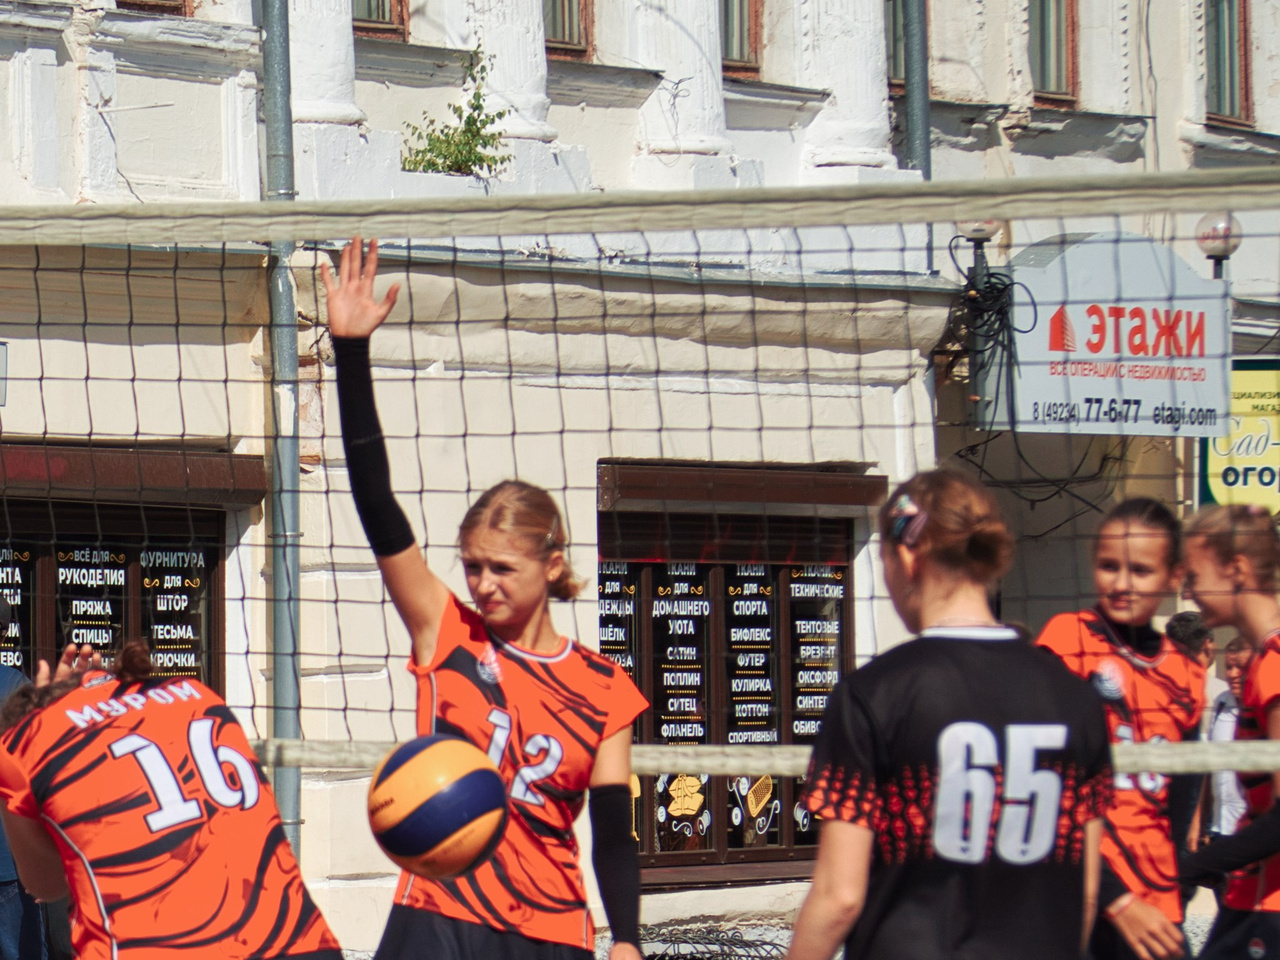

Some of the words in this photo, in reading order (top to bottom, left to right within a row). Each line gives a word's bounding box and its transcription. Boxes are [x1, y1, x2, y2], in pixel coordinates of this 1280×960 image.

[1050, 361, 1067, 376] ВСЕ
[1033, 402, 1040, 421] 8
[1042, 402, 1081, 426] (49234)
[1084, 397, 1142, 424] 77-6-77
[1153, 401, 1217, 432] etagi.com
[74, 548, 90, 562] ВСЁ
[92, 550, 110, 564] ДЛЯ
[140, 551, 205, 568] ФУРНИТУРА
[58, 568, 125, 588] РУКОДЕЛИЯ
[164, 575, 182, 589] ДЛЯ
[605, 581, 620, 594] ДЛЯ
[673, 582, 689, 595] ДЛЯ
[743, 583, 758, 596] ДЛЯ
[790, 584, 844, 598] ТЕХНИЧЕСКИЕ
[72, 600, 112, 615] ПРЯЖА
[156, 594, 188, 611] ШТОР
[599, 600, 634, 617] ДЕЖДЫ
[652, 600, 710, 617] ДОМАШНЕГО
[733, 601, 768, 615] СПОРТА
[151, 625, 193, 639] ТЕСЬМА
[600, 624, 625, 641] ШЁЛК
[668, 620, 695, 635] УЮТА
[730, 628, 771, 641] БИФЛЕКС
[795, 621, 839, 634] ТЕНТОВЫЕ
[72, 629, 113, 646] СПИЦЫ
[667, 647, 696, 660] САТИН
[800, 646, 836, 658] БРЕЗЕНТ
[150, 653, 195, 667] КРЮЧКИ
[737, 653, 766, 667] ФУТЕР
[663, 672, 701, 686] ПОПЛИН
[798, 670, 839, 685] ОКСФОРД
[731, 679, 771, 692] КУЛИРКА
[65, 680, 202, 730] МУРОМ
[668, 698, 697, 713] СИТЕЦ
[735, 704, 769, 717] КОТТОН
[661, 723, 704, 738] ФЛАНЕЛЬ
[728, 728, 778, 743] СПОРТИВНЫЙ
[487, 707, 563, 807] 12
[108, 718, 260, 834] 16
[932, 721, 1068, 865] 65
